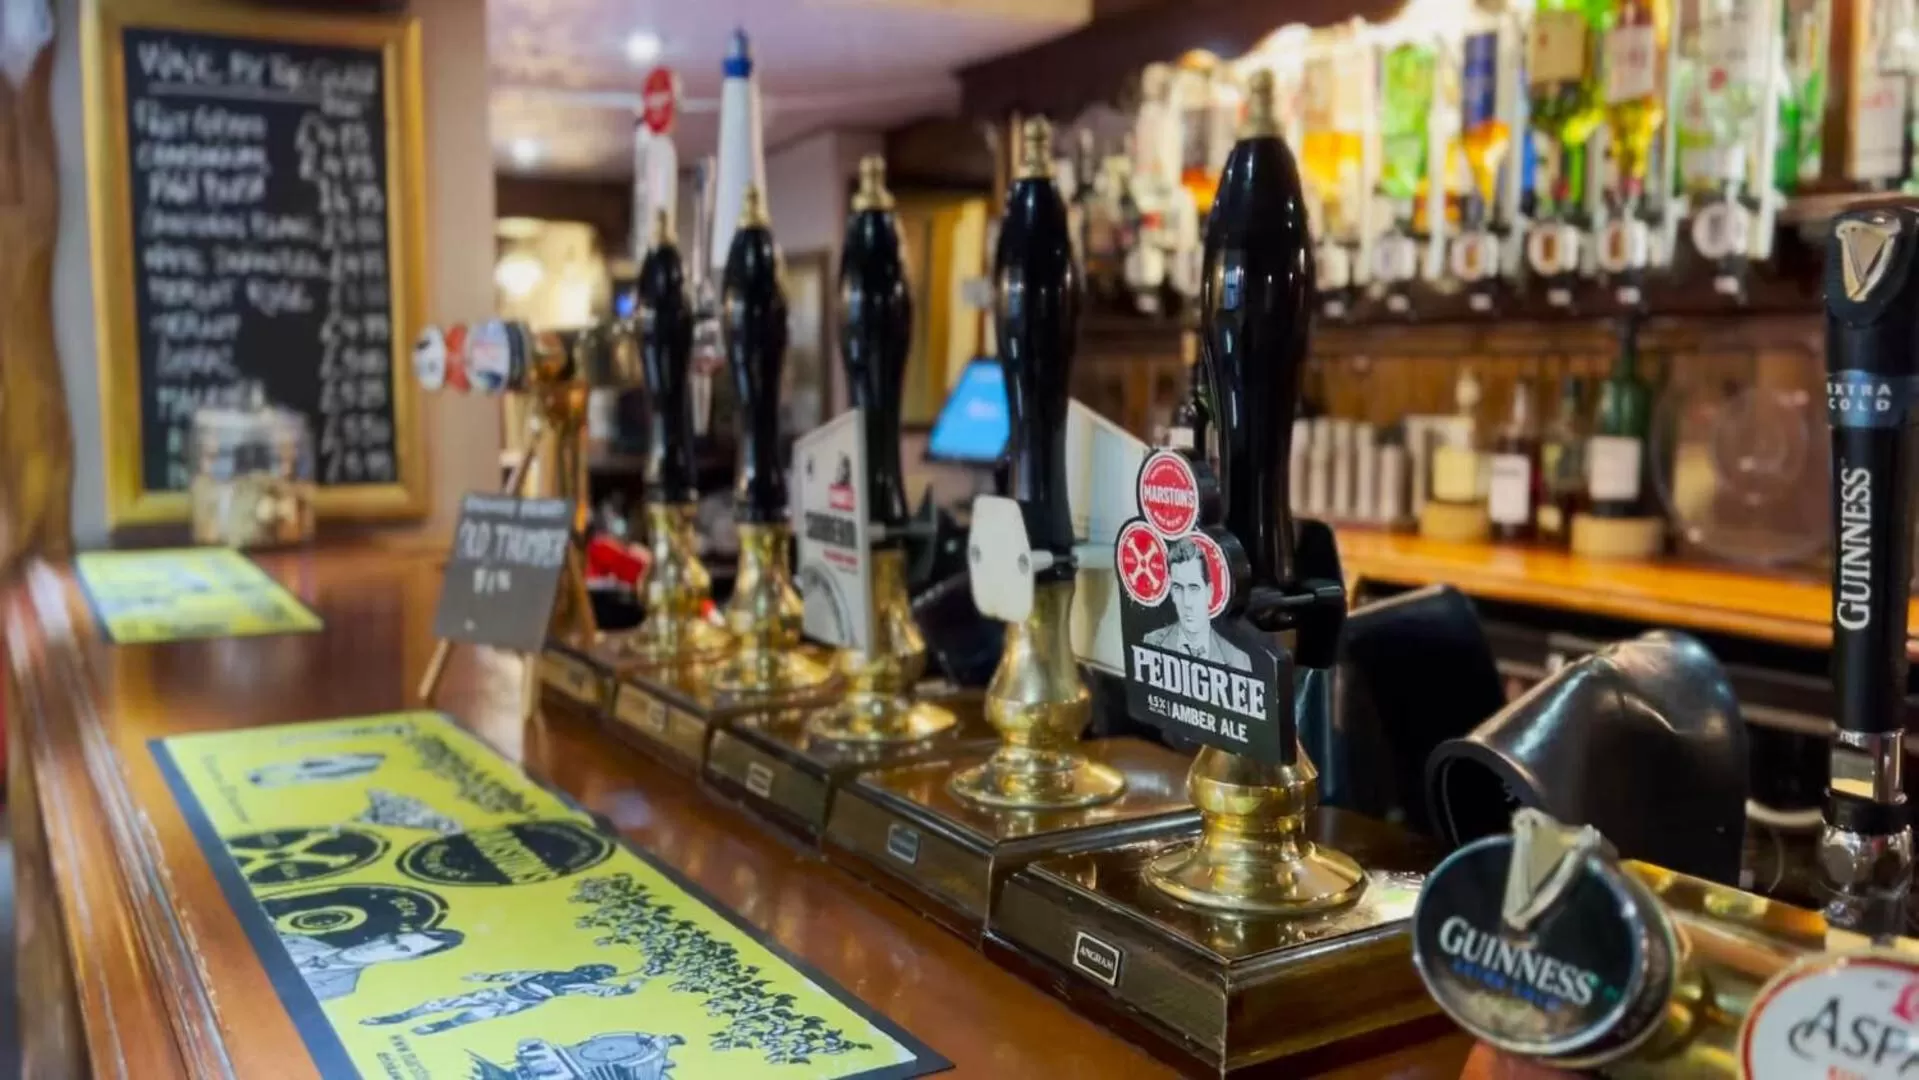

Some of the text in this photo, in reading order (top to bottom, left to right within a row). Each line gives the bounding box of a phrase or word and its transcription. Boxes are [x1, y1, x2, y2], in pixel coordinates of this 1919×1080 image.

[1828, 397, 1891, 412] COLD
[1837, 467, 1872, 631] GUINNESS
[1131, 645, 1267, 720] PEDIGREE
[1171, 702, 1249, 743] AMBER ALE
[1079, 945, 1114, 971] ANGRAM
[1440, 916, 1593, 1007] GUINNESS
